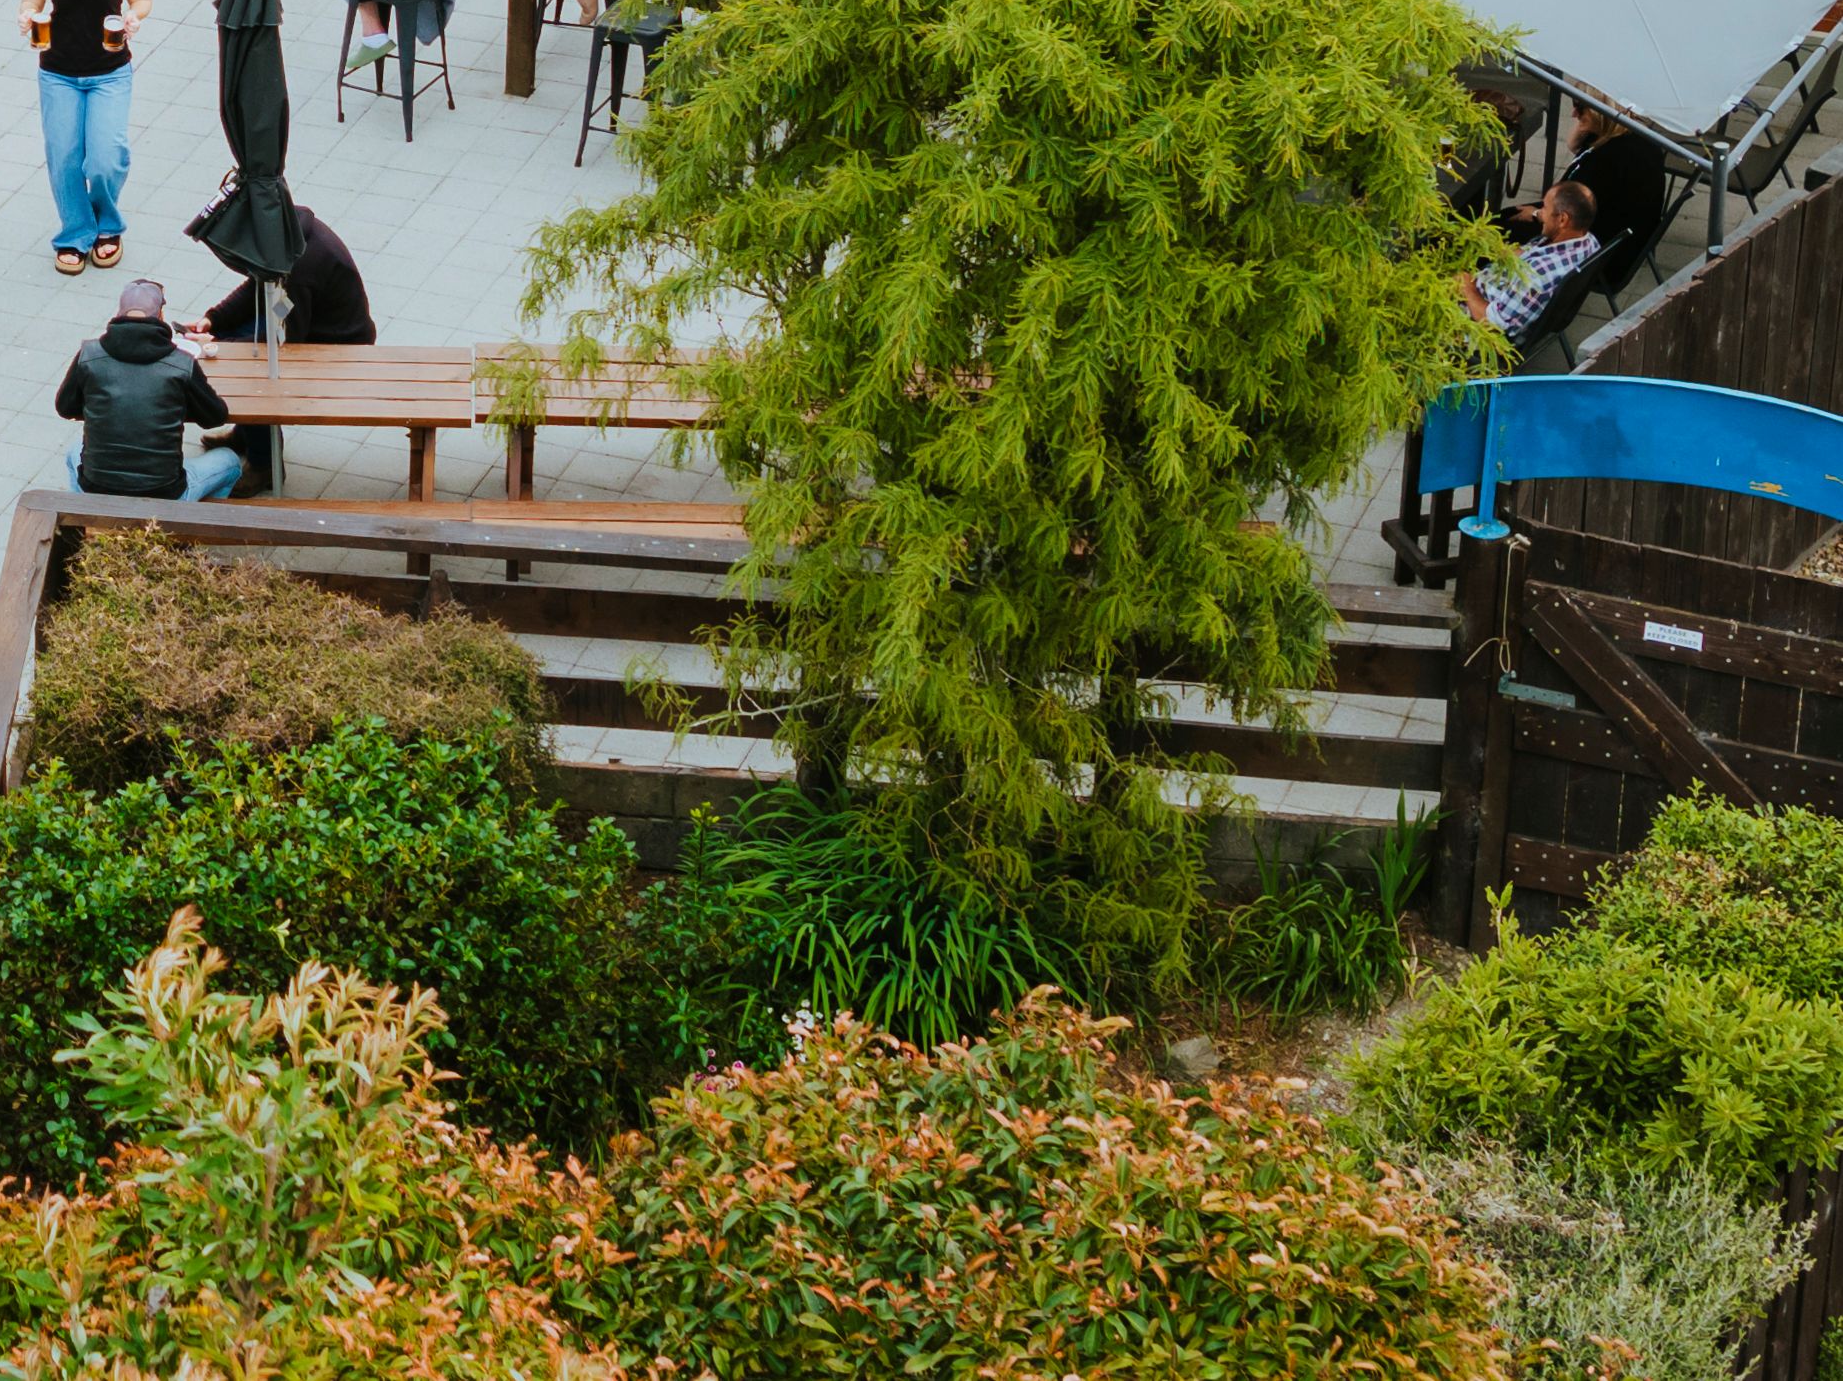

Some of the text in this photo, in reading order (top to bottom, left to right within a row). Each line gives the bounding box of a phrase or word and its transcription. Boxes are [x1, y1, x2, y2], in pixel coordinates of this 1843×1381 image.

[1659, 627, 1687, 636] PLEASE
[1646, 632, 1699, 648] KEEP CLOSED
